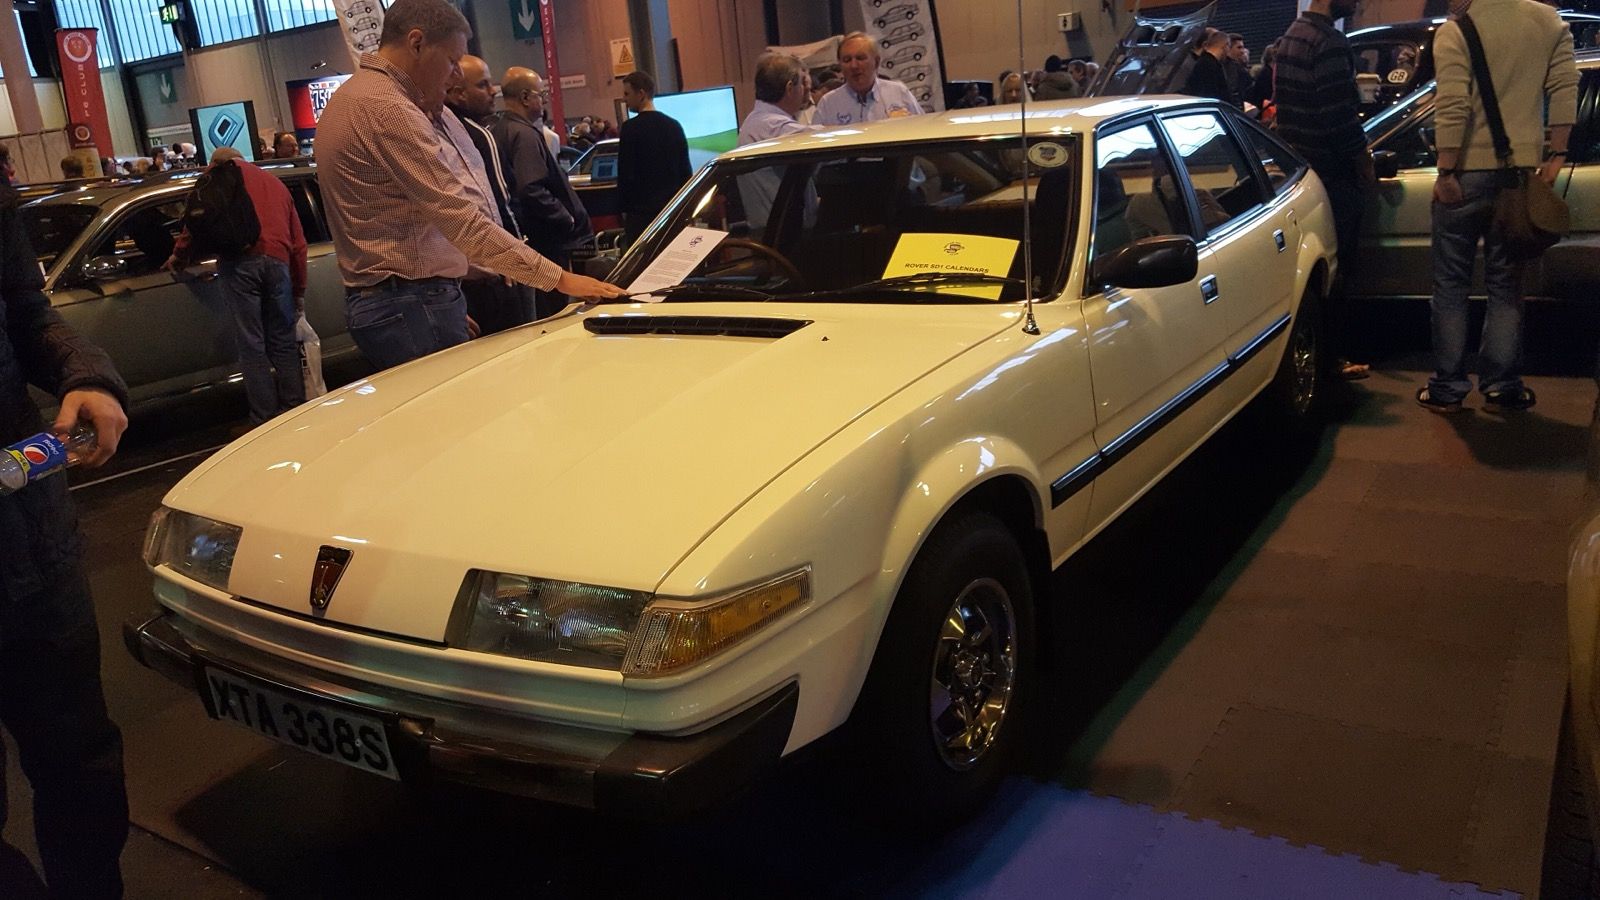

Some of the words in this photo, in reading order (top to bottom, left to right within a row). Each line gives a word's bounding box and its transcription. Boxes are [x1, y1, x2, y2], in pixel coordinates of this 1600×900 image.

[77, 64, 87, 96] CLUB
[1391, 72, 1405, 81] GB
[945, 264, 990, 273] CALENDARS
[209, 675, 279, 737] XTA
[282, 703, 388, 771] 338S
